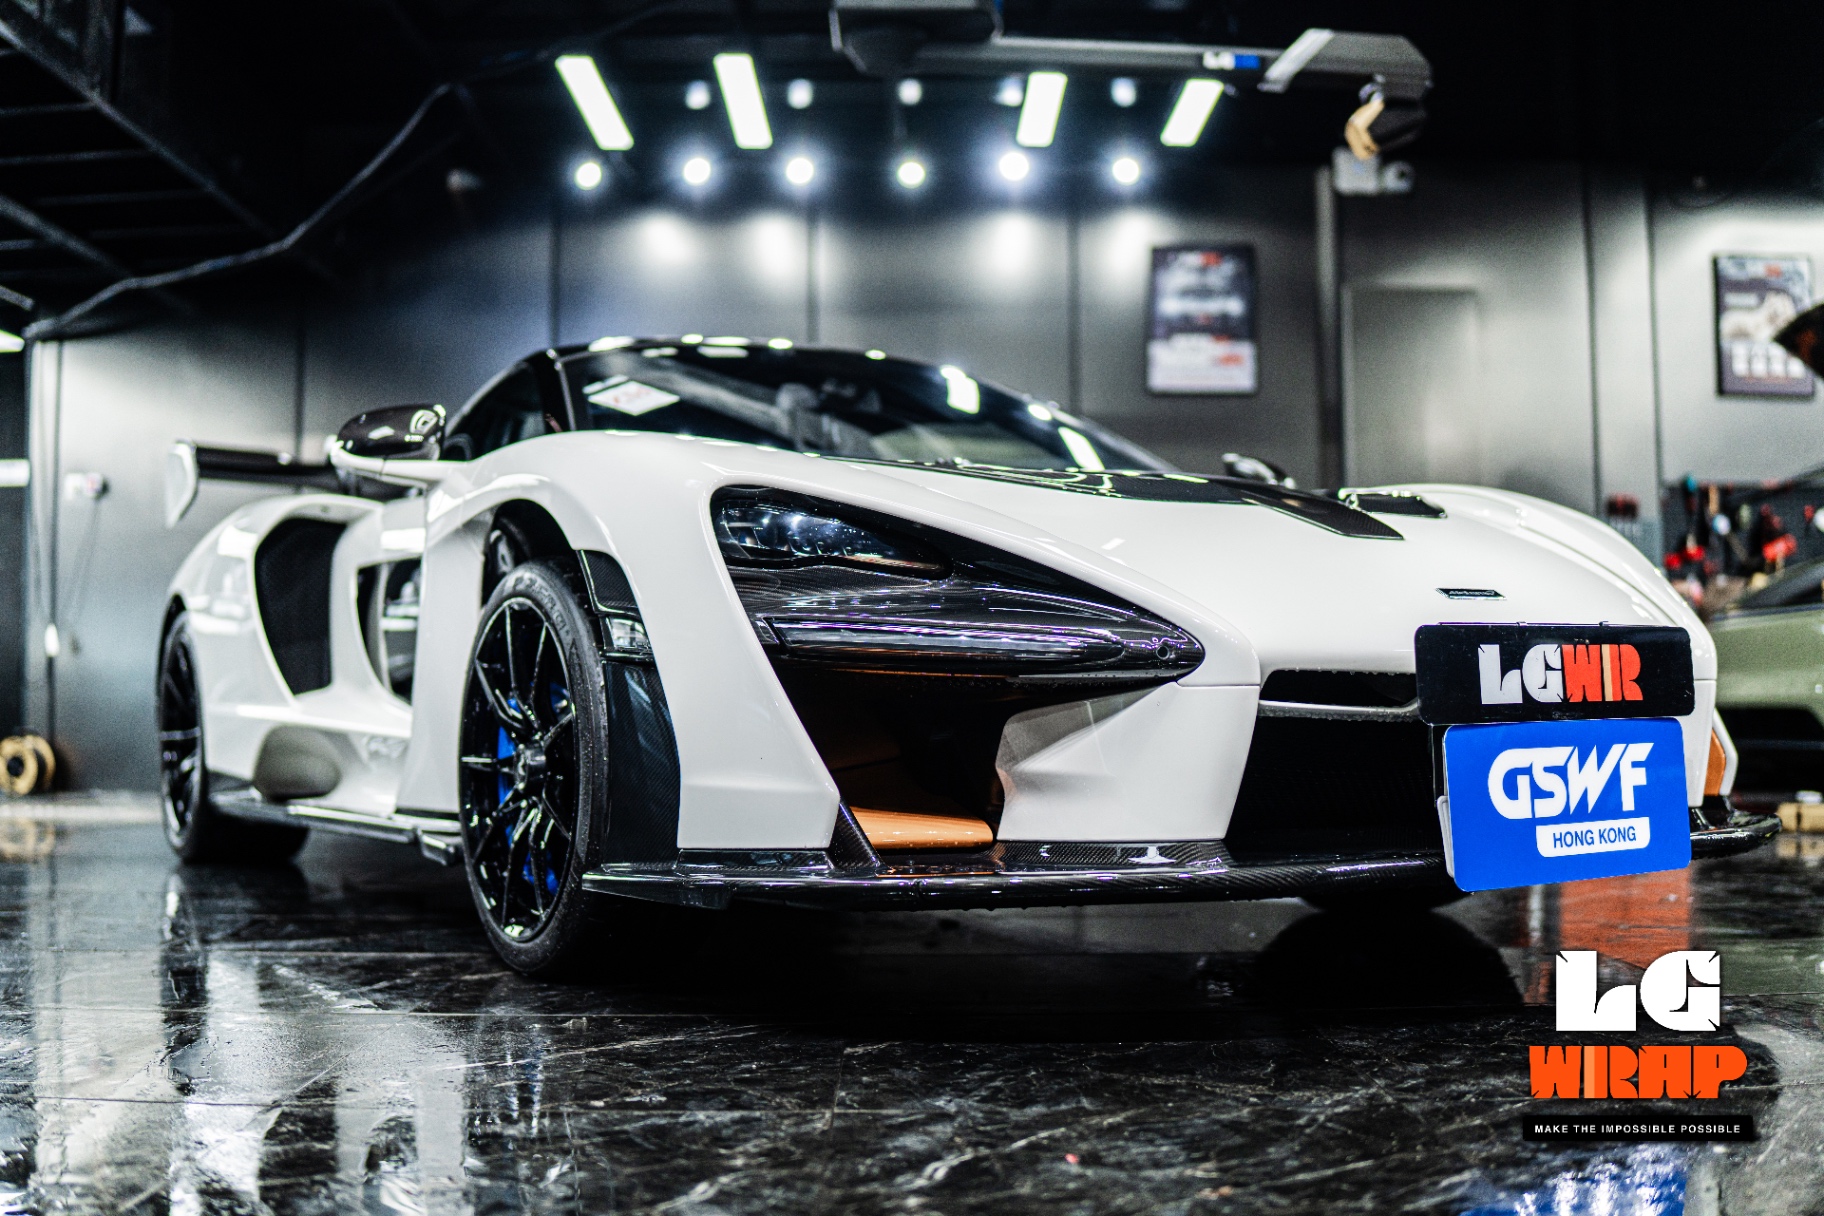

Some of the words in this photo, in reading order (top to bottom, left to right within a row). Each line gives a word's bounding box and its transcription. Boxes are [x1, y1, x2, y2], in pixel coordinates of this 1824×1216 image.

[1487, 742, 1655, 820] GSWF
[1553, 828, 1595, 849] HONG
[1599, 825, 1637, 844] KONG
